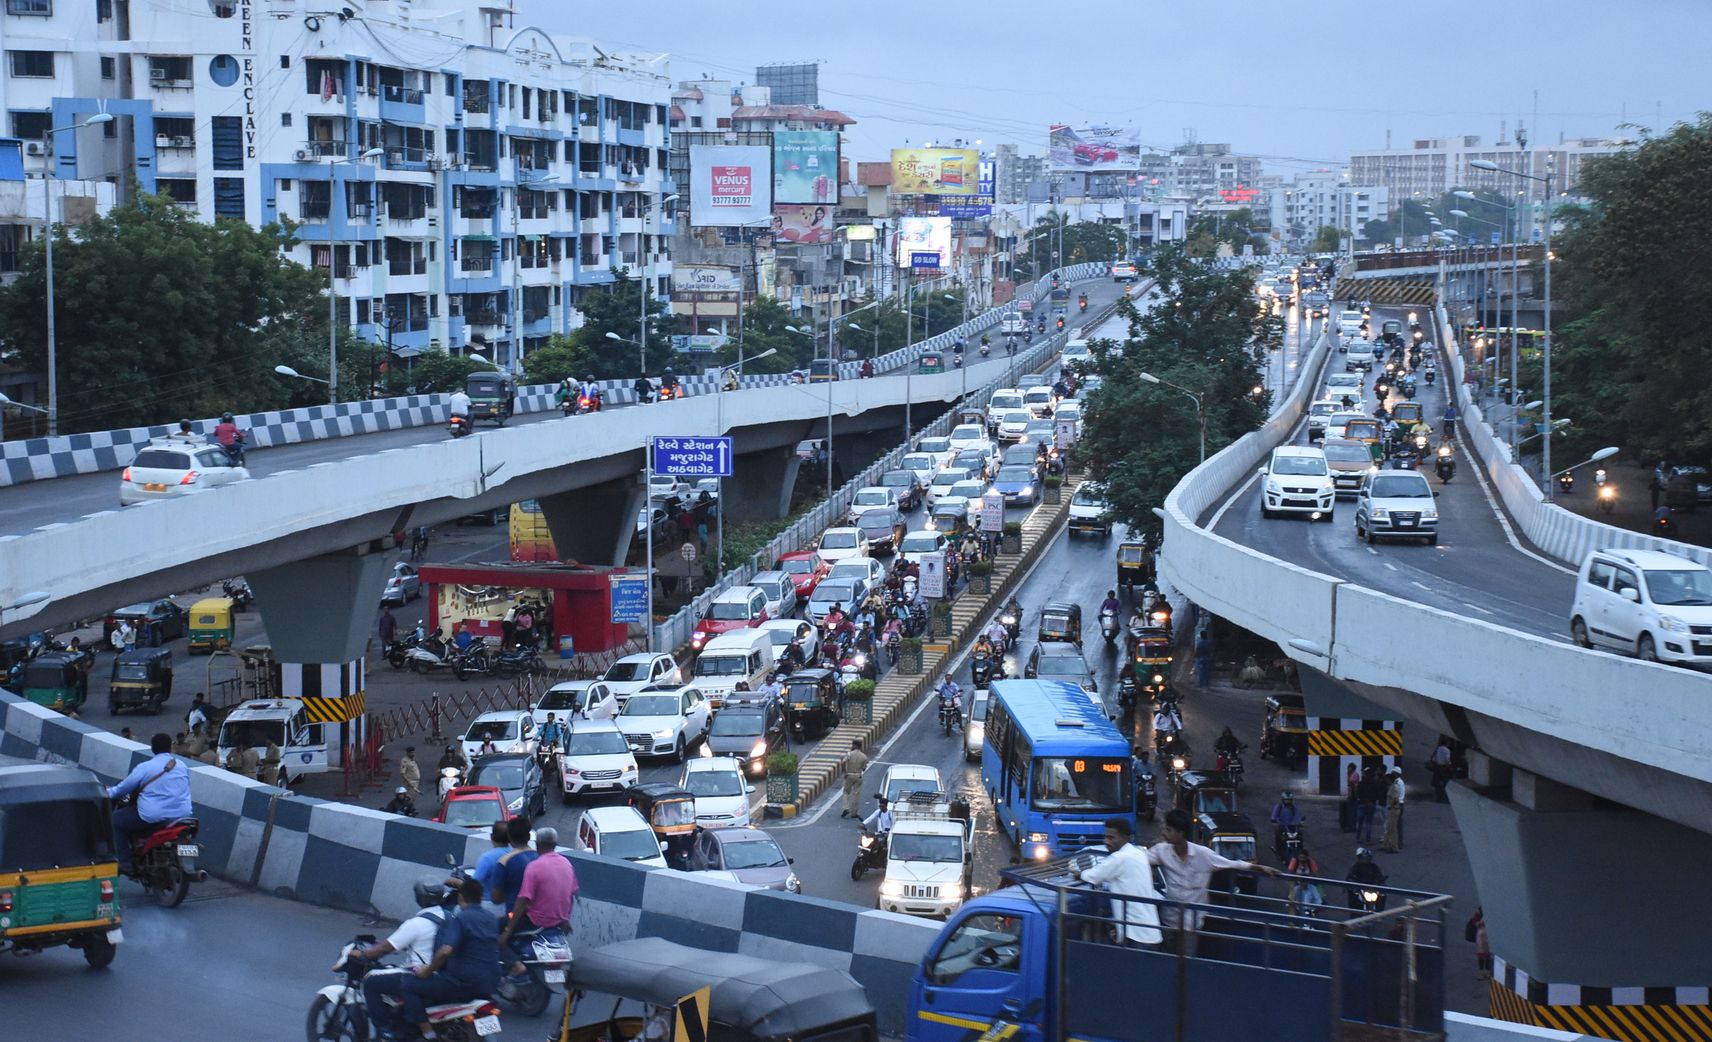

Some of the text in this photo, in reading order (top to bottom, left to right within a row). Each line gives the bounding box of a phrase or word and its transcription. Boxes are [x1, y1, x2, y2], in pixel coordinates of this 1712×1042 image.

[243, 58, 256, 159] ENCLAVE
[714, 175, 749, 185] VENUS
[718, 187, 746, 195] mercury
[712, 196, 731, 204] 93777
[913, 256, 938, 264] GO SLOW
[658, 439, 714, 450] રેલ્વે સ્ટેશન
[670, 451, 714, 465] મજુરાગેટ
[667, 463, 714, 473] અઠવાગેટ
[1074, 760, 1085, 773] 03
